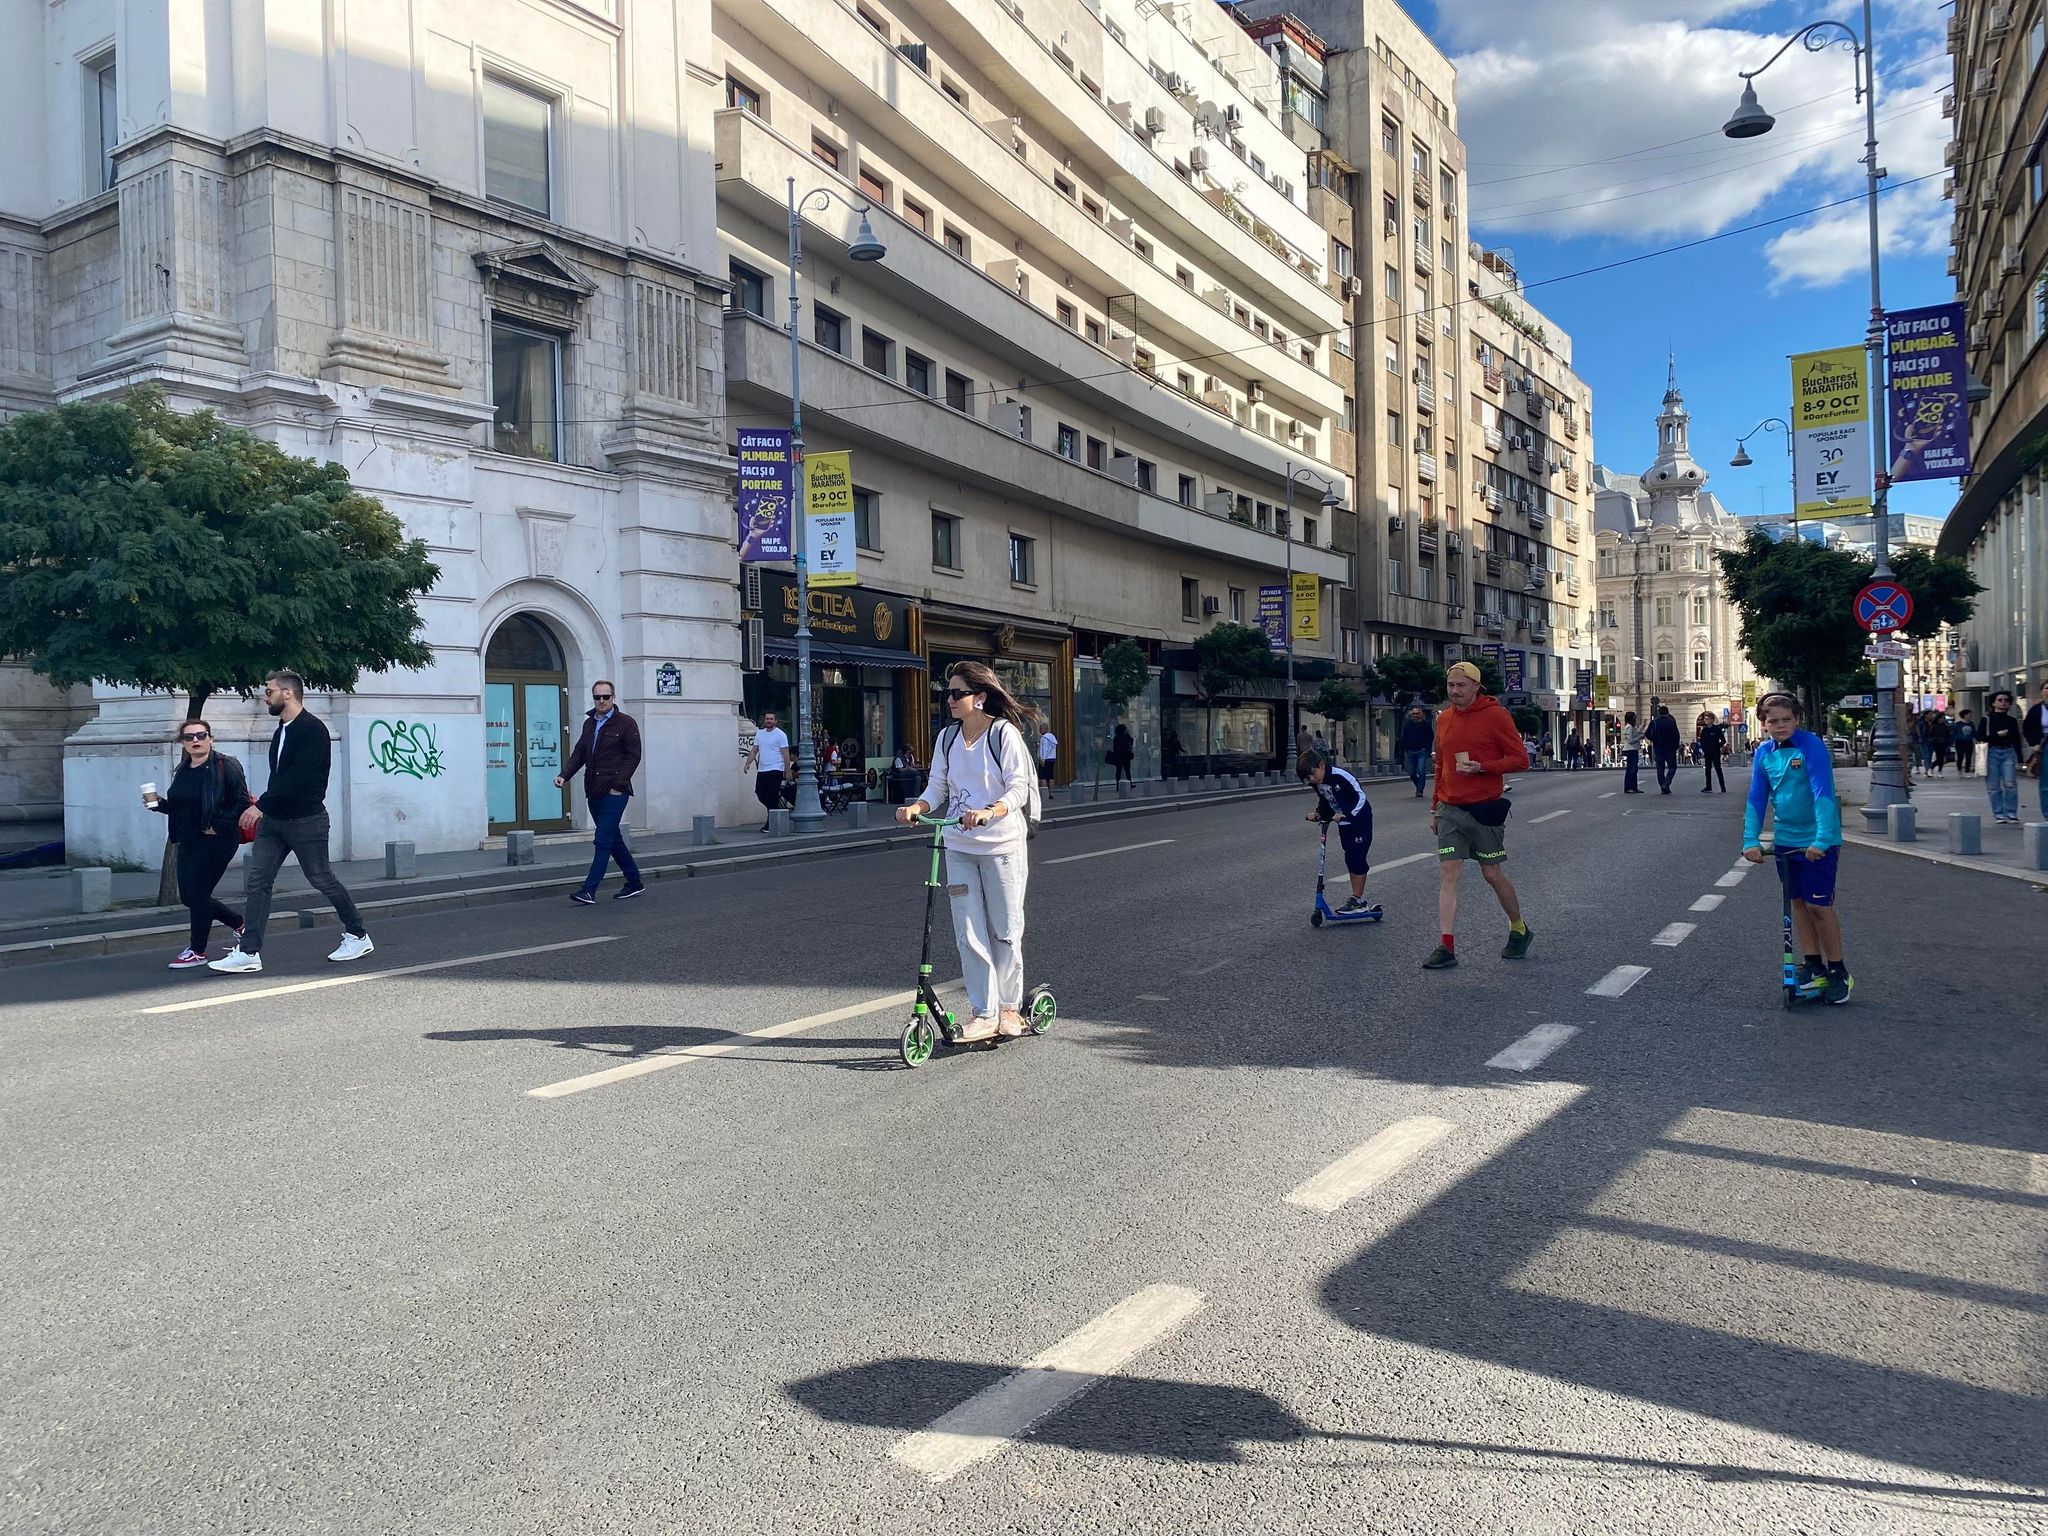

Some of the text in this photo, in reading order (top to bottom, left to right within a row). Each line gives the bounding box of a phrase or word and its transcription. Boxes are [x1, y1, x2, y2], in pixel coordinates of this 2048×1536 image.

[1890, 317, 1950, 335] CÂT FACI O
[1891, 334, 1960, 354] PLIMBARE,
[1893, 359, 1917, 372] FACI
[1931, 356, 1940, 368] O
[1802, 370, 1858, 387] Bucharest
[1893, 372, 1952, 390] PORTARE
[1803, 380, 1858, 396] MARATHON
[1804, 395, 1860, 412] 8-9 OCT
[1804, 408, 1860, 420] #DareFurther
[1808, 431, 1838, 439] POPULAR
[742, 436, 782, 447] CÂT FACI O
[742, 451, 787, 462] PLIMBARE,
[1924, 448, 1954, 459] HAI PE
[1924, 458, 1965, 469] YOXO.RO
[742, 467, 758, 475] FACI
[769, 467, 775, 475] O
[811, 471, 845, 481] Bucharest
[1816, 471, 1839, 485] EY
[742, 480, 782, 490] PORTARE
[812, 480, 846, 488] MARATHON
[812, 491, 847, 502] 8-9 OCT
[821, 550, 836, 560] EY
